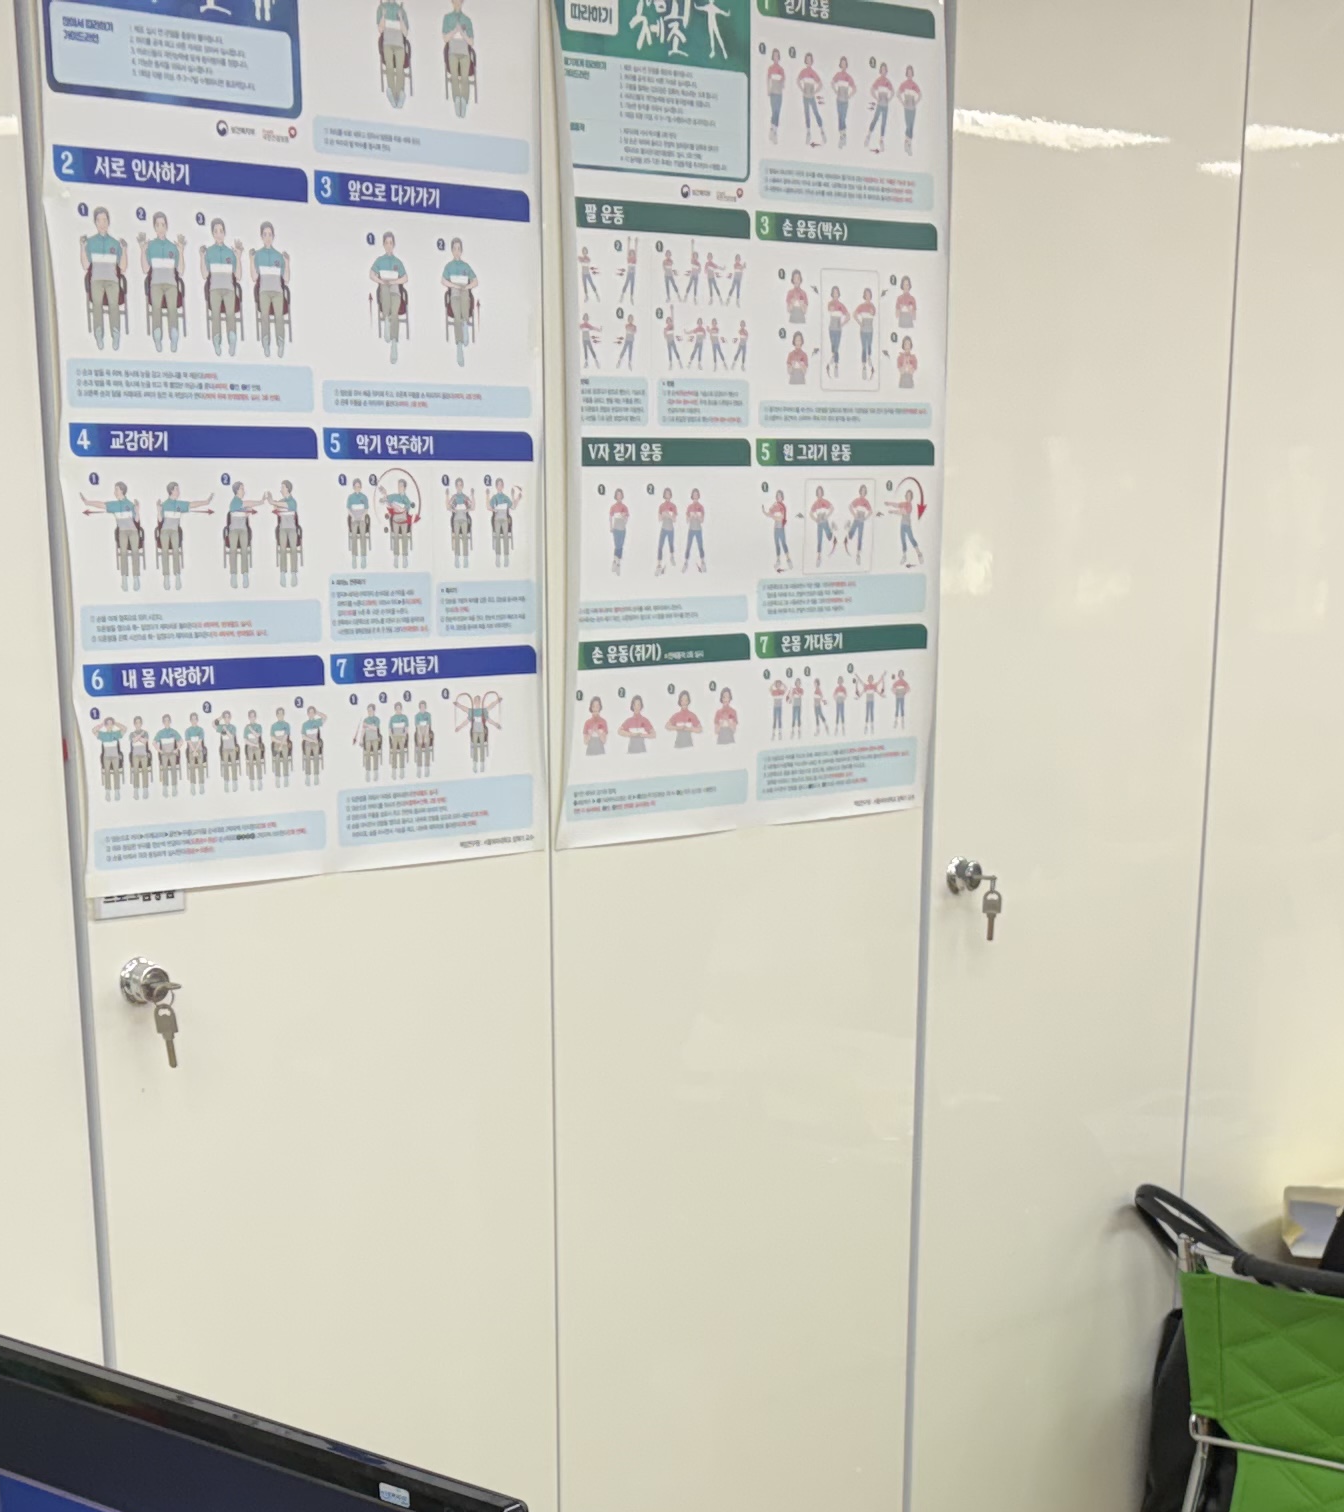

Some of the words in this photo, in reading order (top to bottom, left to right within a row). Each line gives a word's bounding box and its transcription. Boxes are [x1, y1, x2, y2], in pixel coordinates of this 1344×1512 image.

[570, 4, 613, 24] 따라하기
[60, 151, 74, 174] 2
[94, 156, 126, 178] 서로
[132, 158, 190, 185] 인사하기
[321, 176, 332, 198] 3
[348, 179, 386, 202] 앞으로
[391, 183, 440, 209] 다가가기
[585, 203, 597, 223] 팔
[601, 204, 624, 225] 운동
[760, 216, 769, 234] 3
[782, 218, 793, 232] 손
[796, 219, 848, 241] 운동(박수)
[76, 428, 91, 450] 4
[110, 430, 168, 451] 교감하기
[330, 433, 341, 453] 5
[356, 434, 381, 454] 악기
[385, 435, 434, 455] 연주하기
[588, 443, 610, 461] V자
[613, 443, 637, 461] 걷기
[640, 443, 663, 462] 운동
[761, 443, 770, 461] 5
[783, 444, 794, 461] 원
[796, 443, 827, 461] 그리기
[831, 444, 852, 462] 운동
[760, 635, 769, 652] 7
[781, 635, 802, 652] 온몸
[804, 632, 843, 651] 가다듬기
[591, 647, 604, 665] 손
[606, 643, 662, 664] 운동(쥐기)
[336, 658, 347, 678] 7
[363, 657, 387, 677] 온몸
[391, 655, 439, 676] 가다듬기
[91, 668, 104, 690] 6
[122, 669, 137, 690] 내
[142, 668, 156, 688] 몸
[160, 666, 215, 687] 사랑하기
